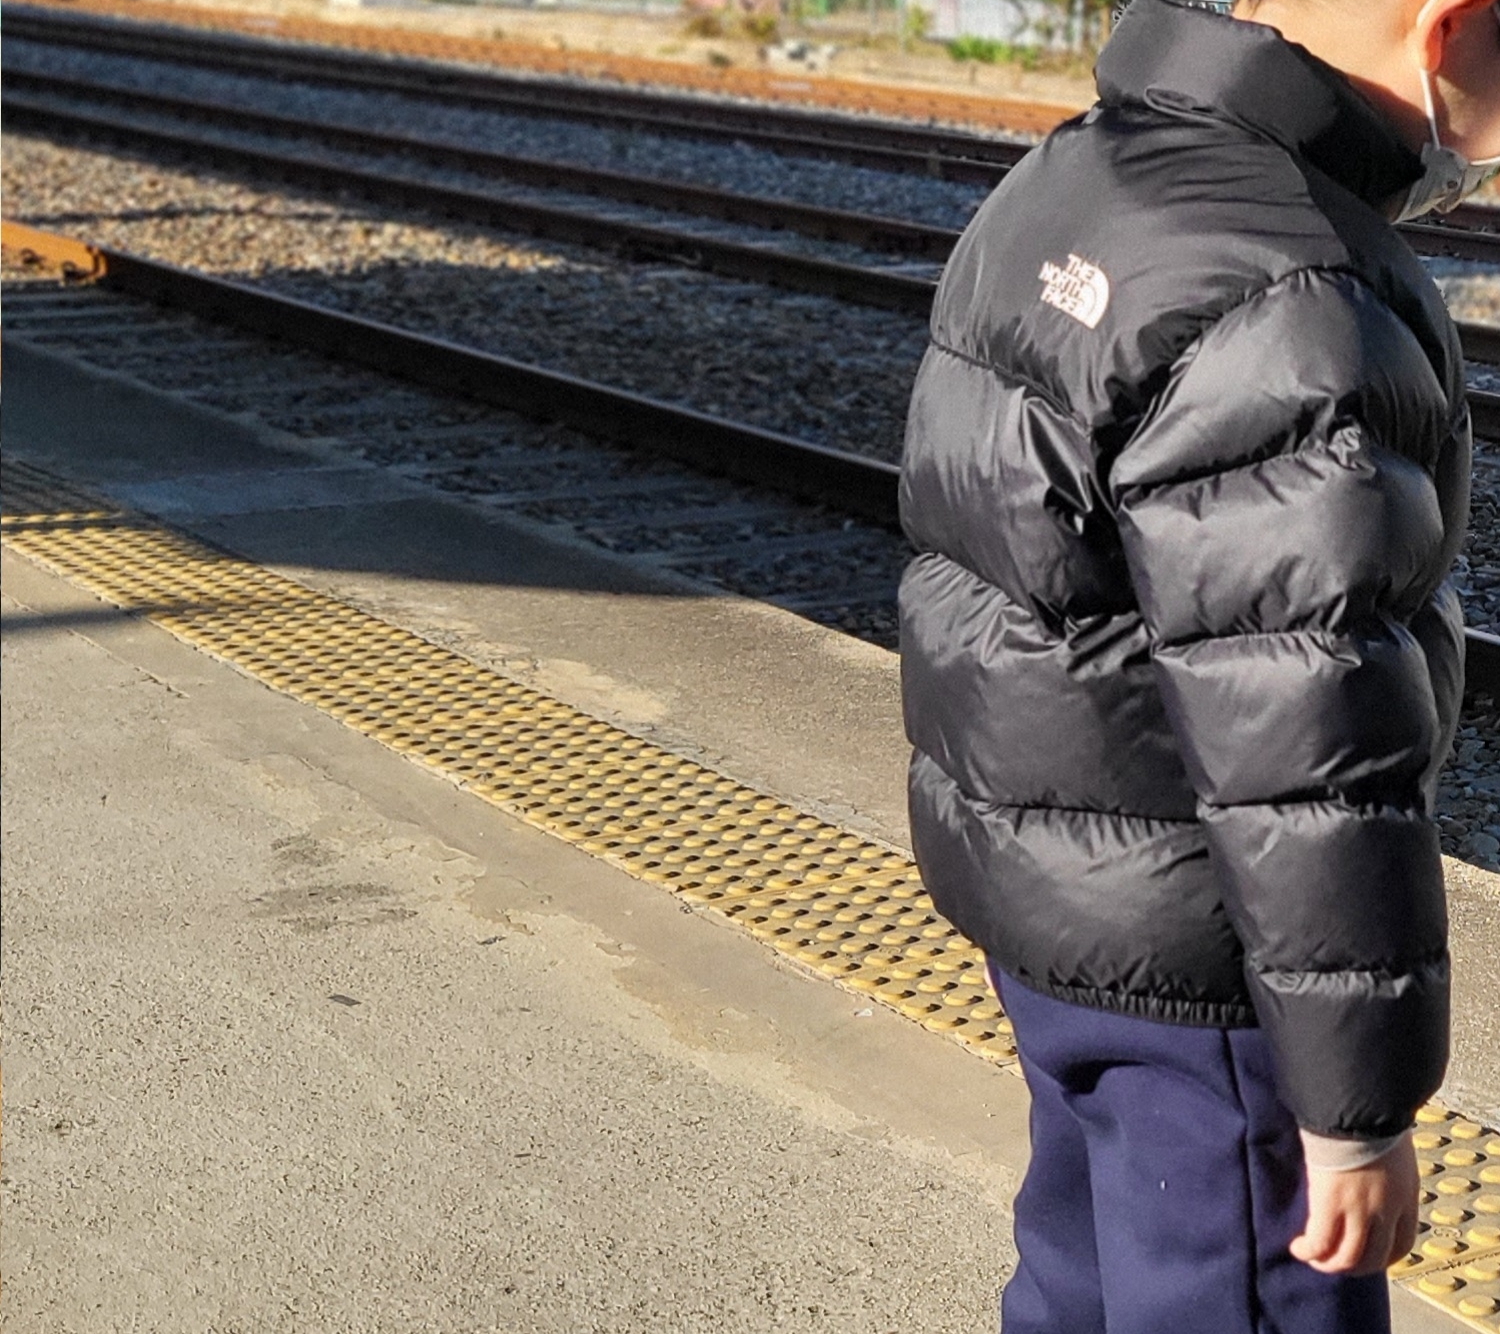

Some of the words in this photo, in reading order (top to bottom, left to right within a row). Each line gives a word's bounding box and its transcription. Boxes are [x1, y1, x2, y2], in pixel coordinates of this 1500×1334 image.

[1038, 261, 1086, 300] NORTH
[1065, 253, 1096, 282] THE
[1040, 284, 1079, 314] FACE
